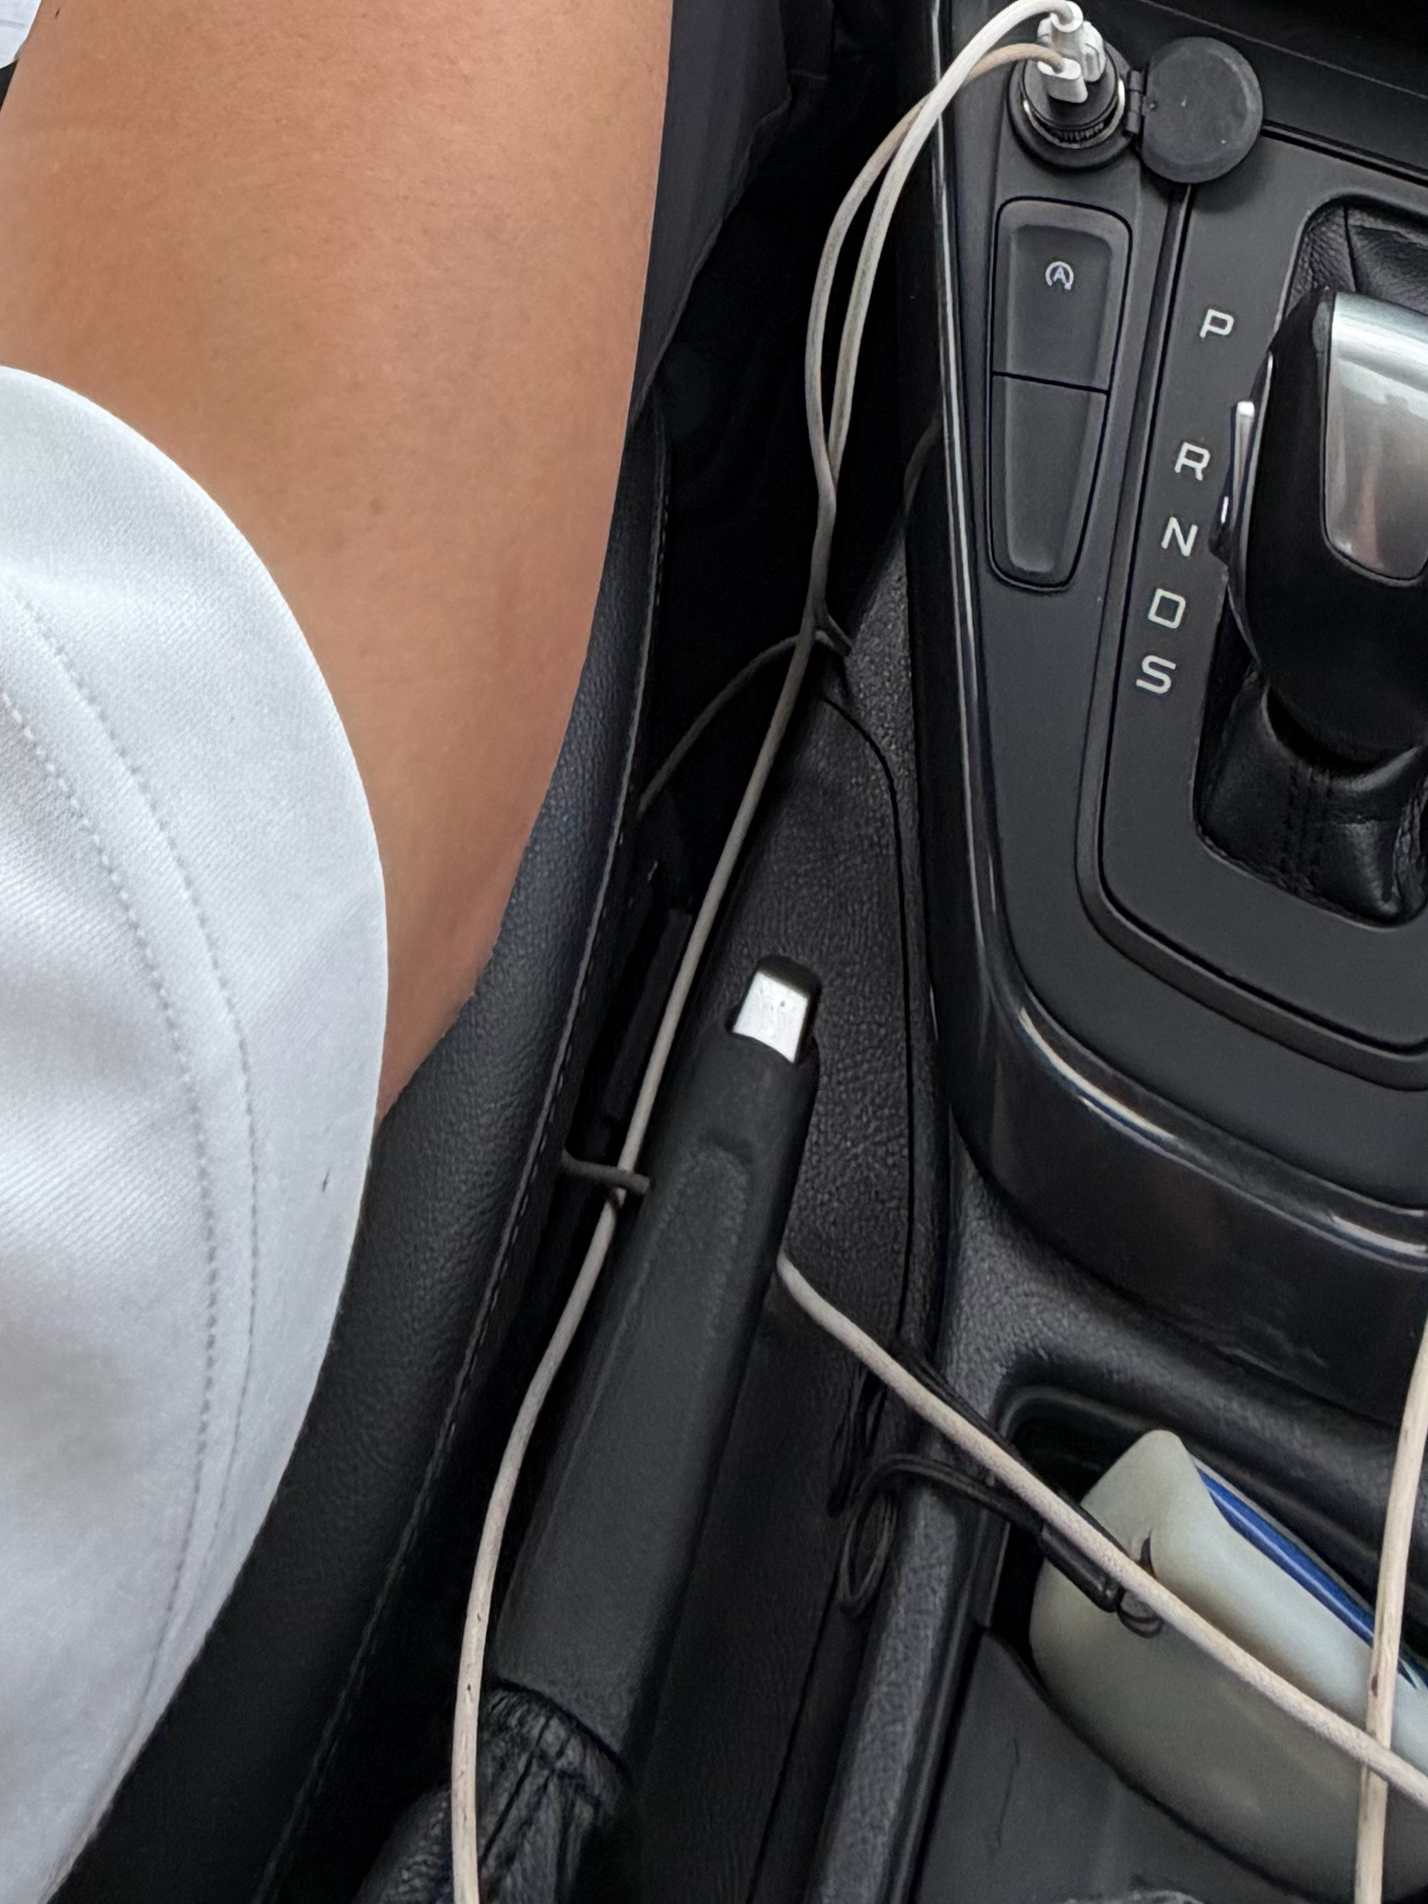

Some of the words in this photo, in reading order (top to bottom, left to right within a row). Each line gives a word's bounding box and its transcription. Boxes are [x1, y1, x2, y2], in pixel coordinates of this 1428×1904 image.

[1198, 308, 1234, 340] P
[1174, 442, 1211, 481] R
[1161, 516, 1198, 557] N
[1147, 588, 1186, 629] D
[1136, 654, 1177, 695] S
